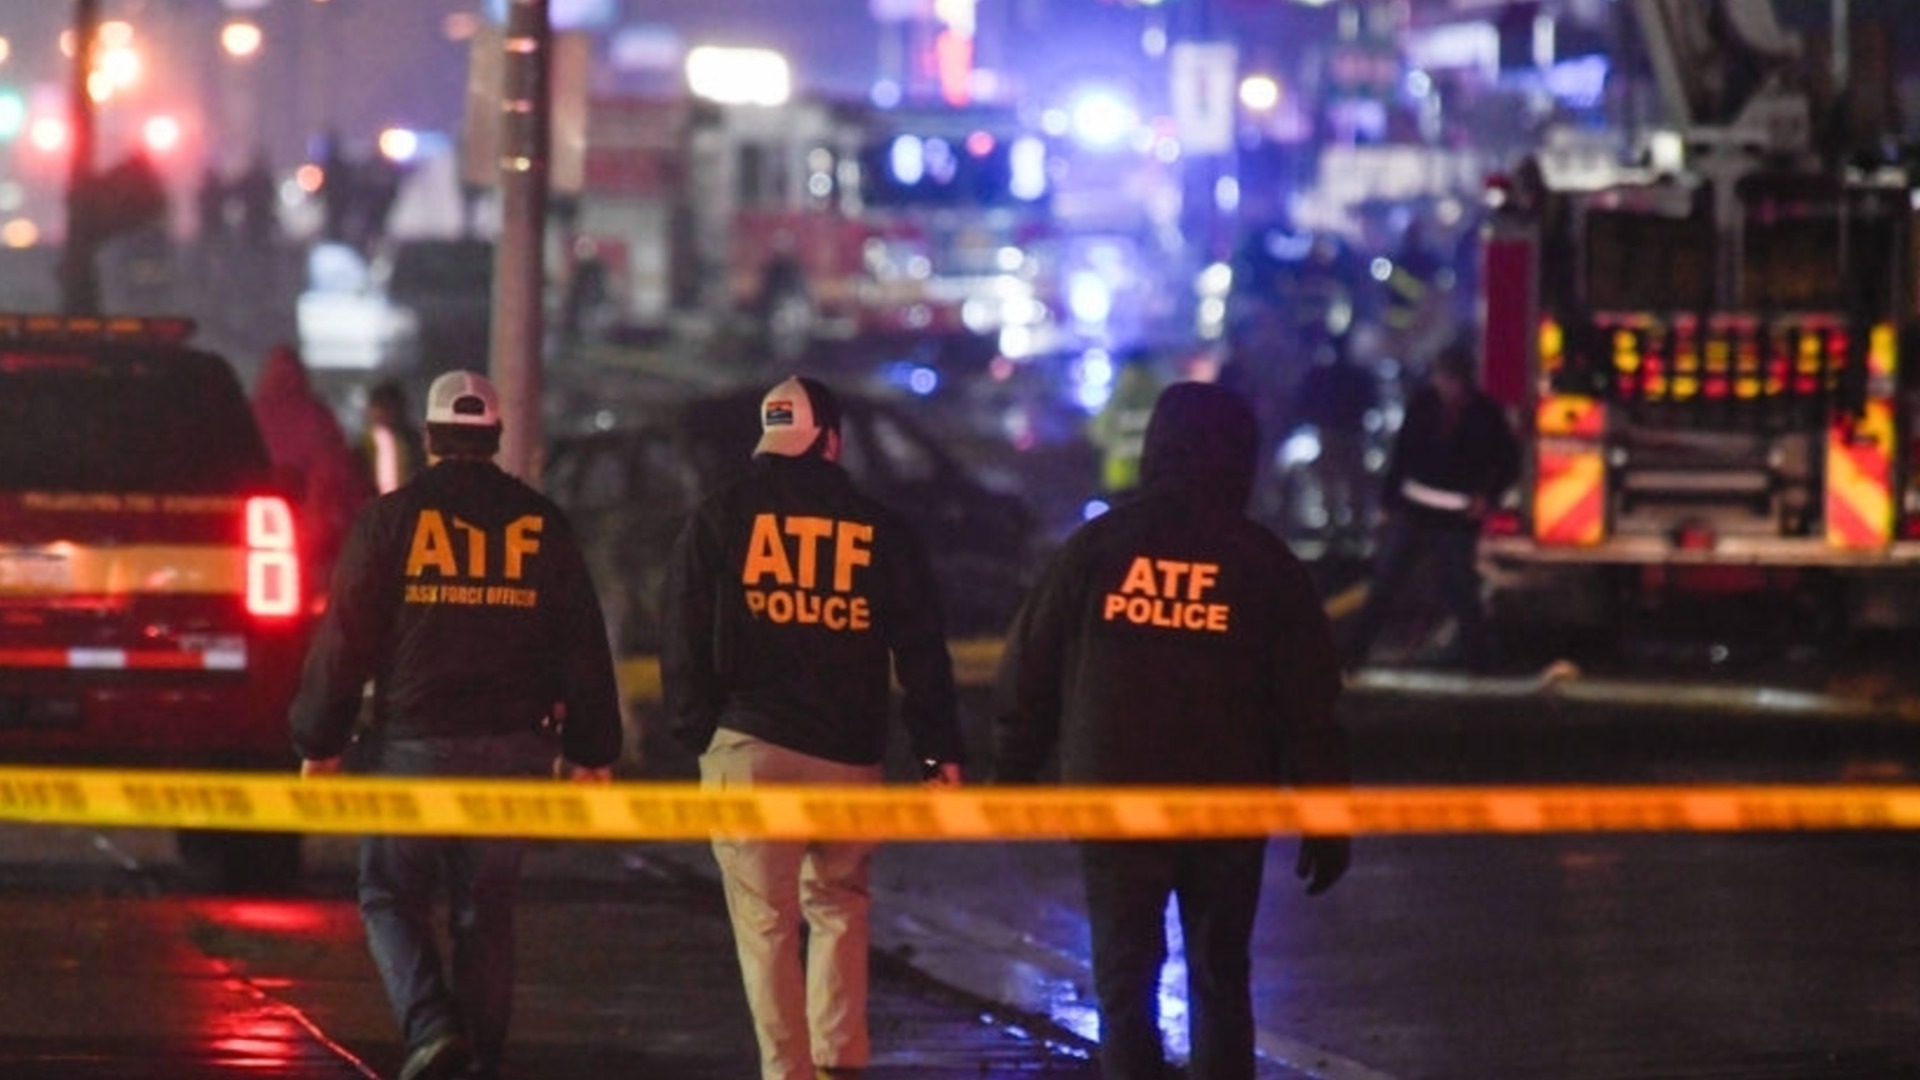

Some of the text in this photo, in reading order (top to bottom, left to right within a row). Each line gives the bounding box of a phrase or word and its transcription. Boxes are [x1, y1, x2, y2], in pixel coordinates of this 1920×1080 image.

[405, 509, 544, 580] ATF
[742, 513, 874, 592] ATF
[440, 585, 483, 605] FORCE
[1121, 556, 1219, 600] ATF
[745, 590, 870, 631] POLICE
[1103, 593, 1230, 632] POLICE
